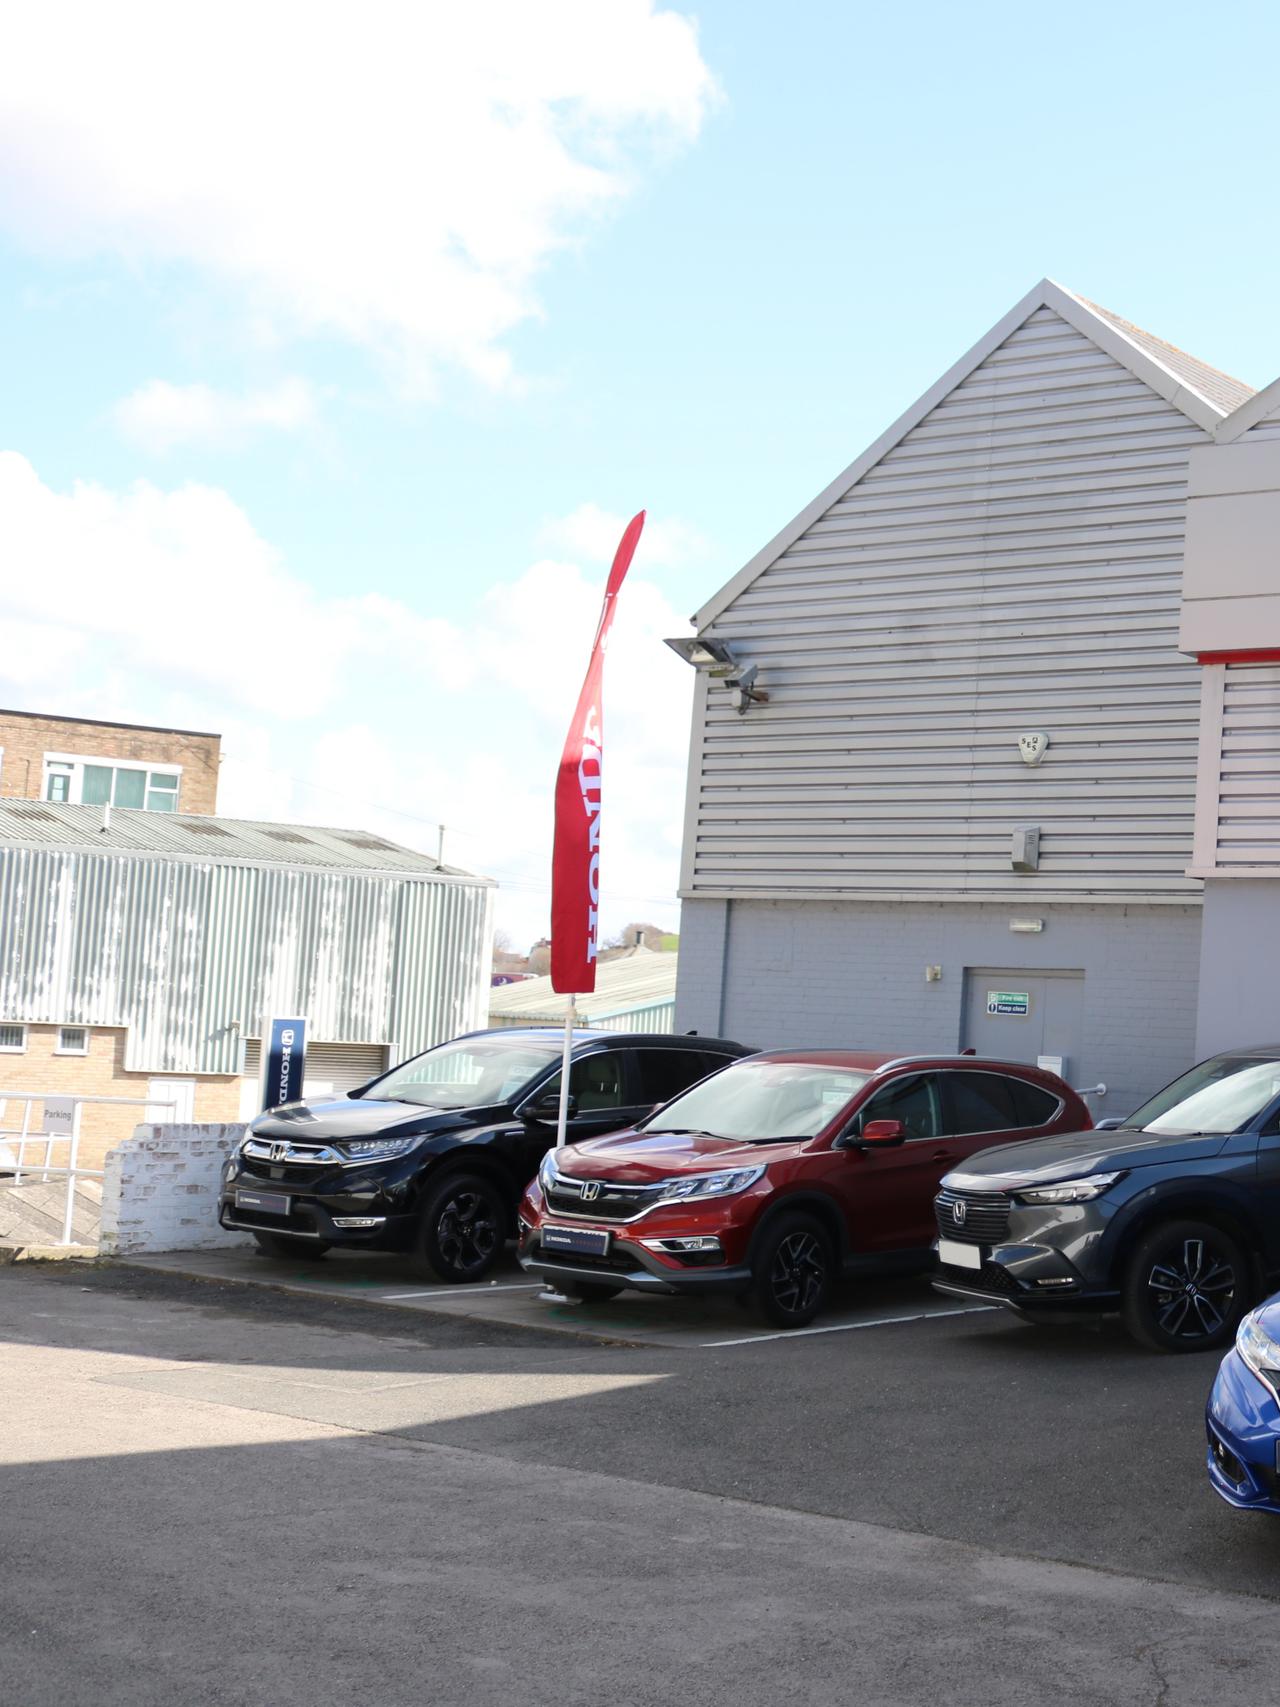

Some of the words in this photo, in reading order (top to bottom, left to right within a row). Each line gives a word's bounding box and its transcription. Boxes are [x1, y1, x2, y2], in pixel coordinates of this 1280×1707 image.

[998, 1004, 1011, 1012] Keep
[279, 1046, 292, 1105] HOND
[44, 1109, 71, 1121] Parking
